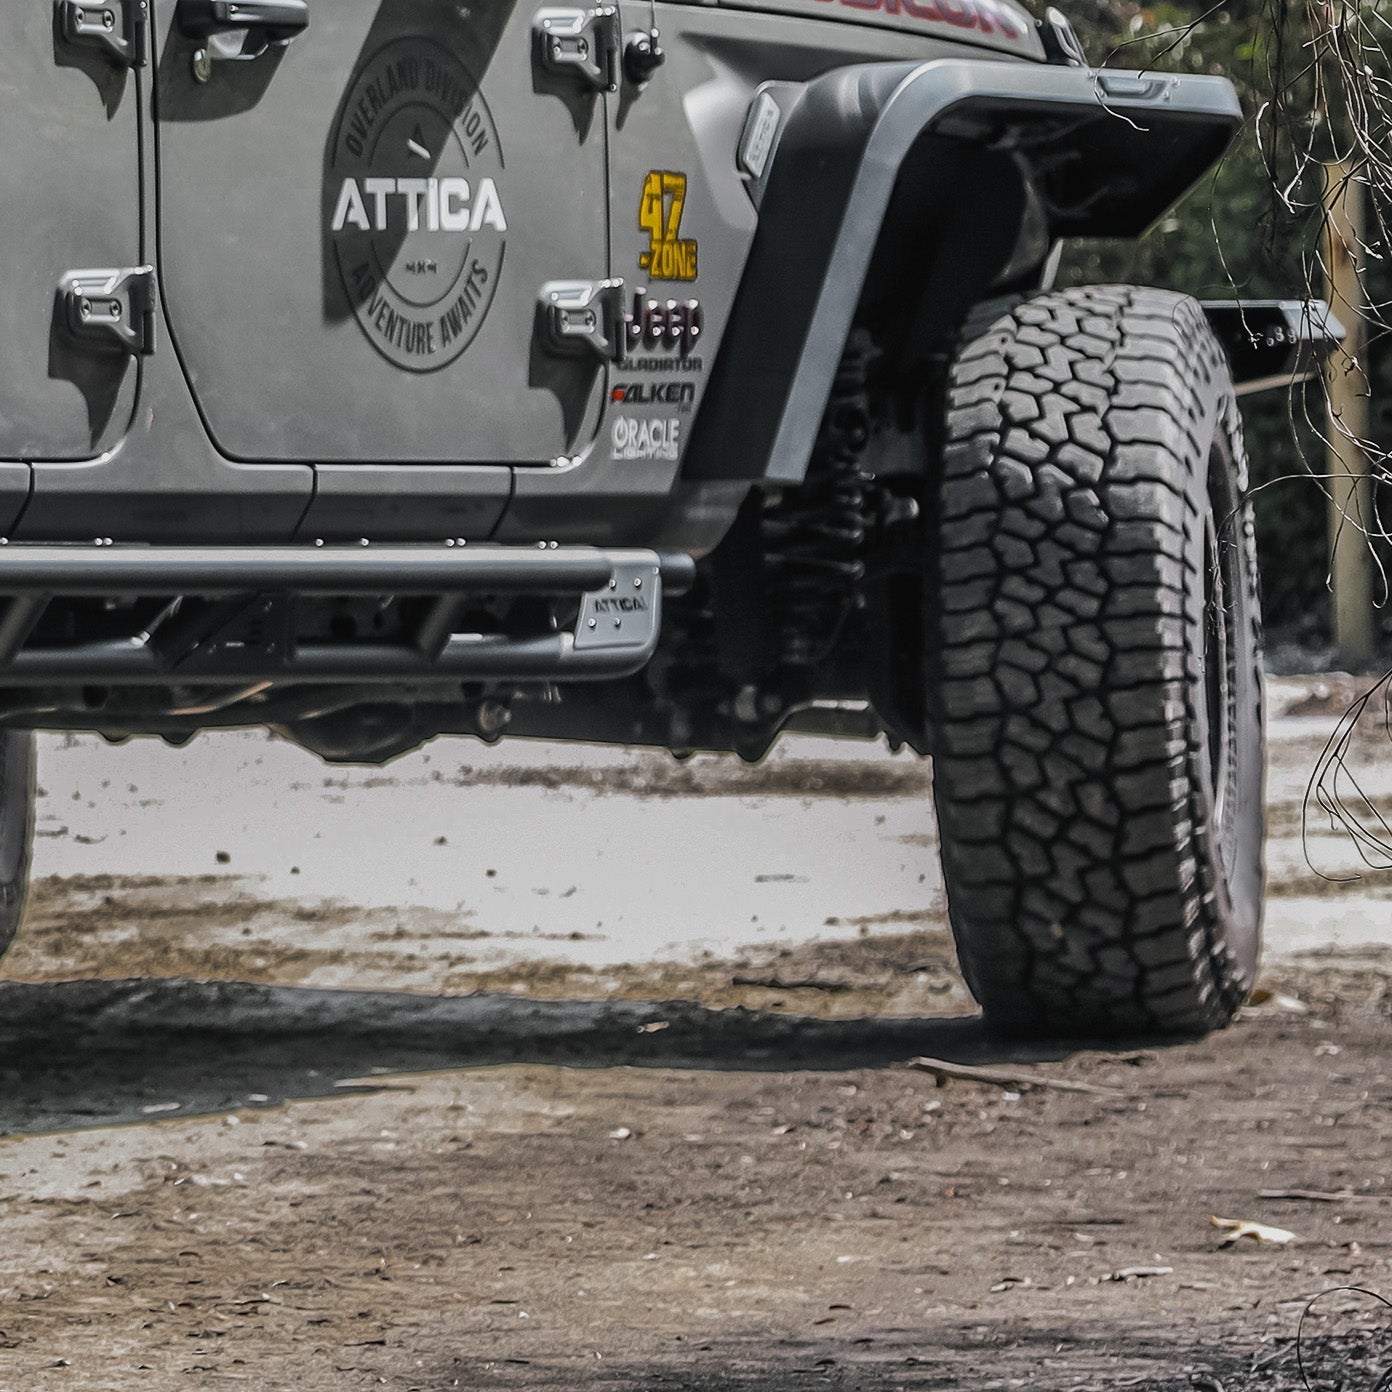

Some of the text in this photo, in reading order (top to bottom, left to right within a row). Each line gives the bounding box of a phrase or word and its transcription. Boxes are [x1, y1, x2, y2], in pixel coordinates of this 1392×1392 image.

[332, 178, 508, 232] ATTICA
[352, 259, 488, 355] ADVENTURE AWAITS
[624, 286, 704, 358] Jeep
[611, 382, 696, 404] FALKEN
[612, 416, 679, 449] ORACLE
[595, 595, 643, 613] ATTICA
